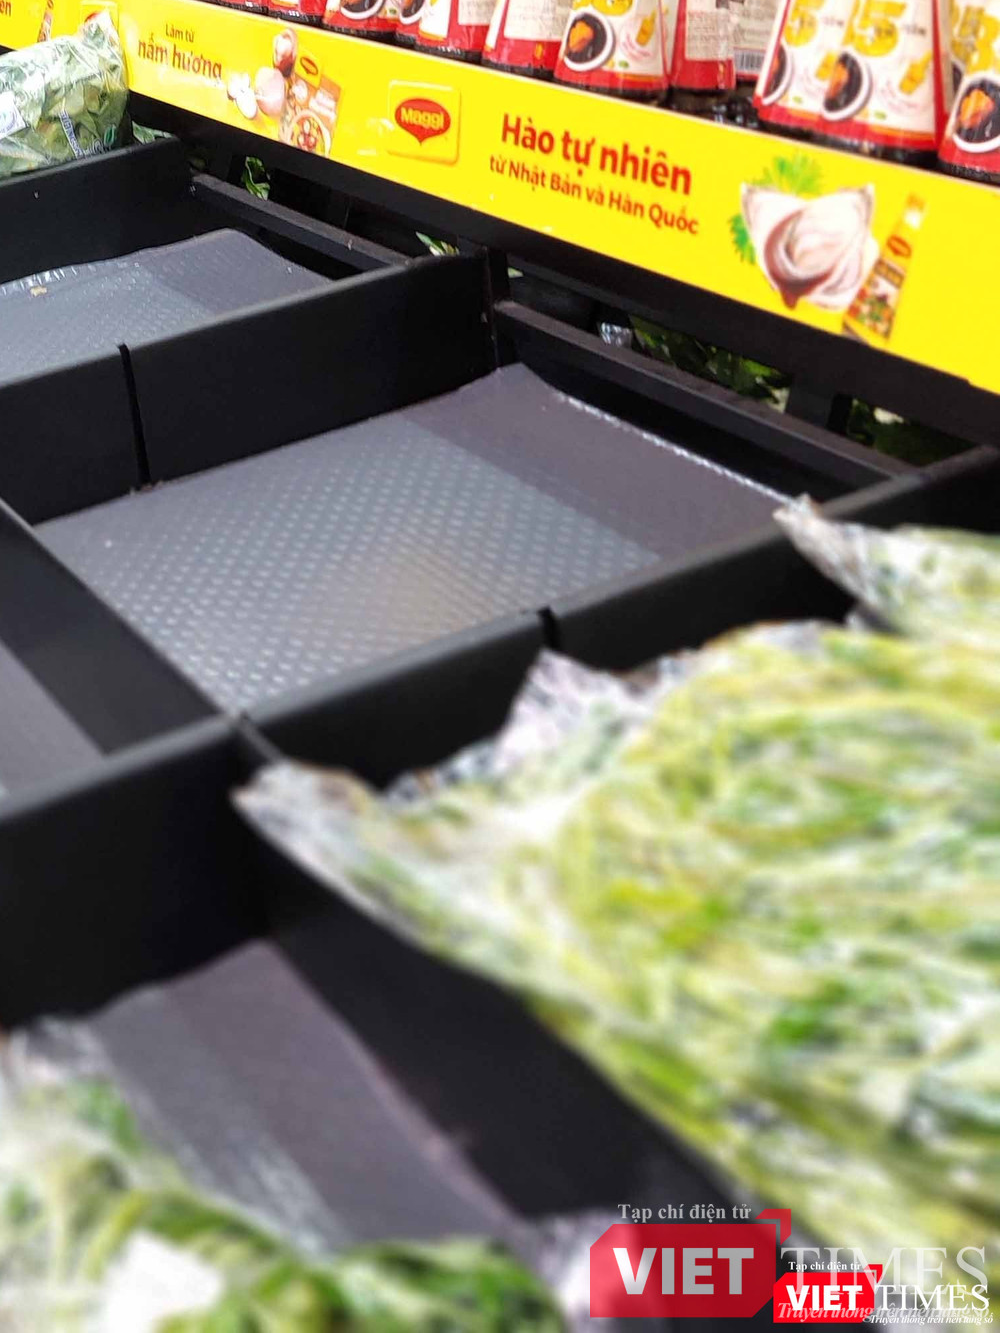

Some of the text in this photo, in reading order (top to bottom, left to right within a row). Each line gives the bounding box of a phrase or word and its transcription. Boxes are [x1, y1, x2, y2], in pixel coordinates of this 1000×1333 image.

[138, 31, 223, 84] nấm hương
[490, 154, 700, 235] từ Nhật Bản và Hàn Quốc
[501, 113, 693, 196] Hào tự nhiên
